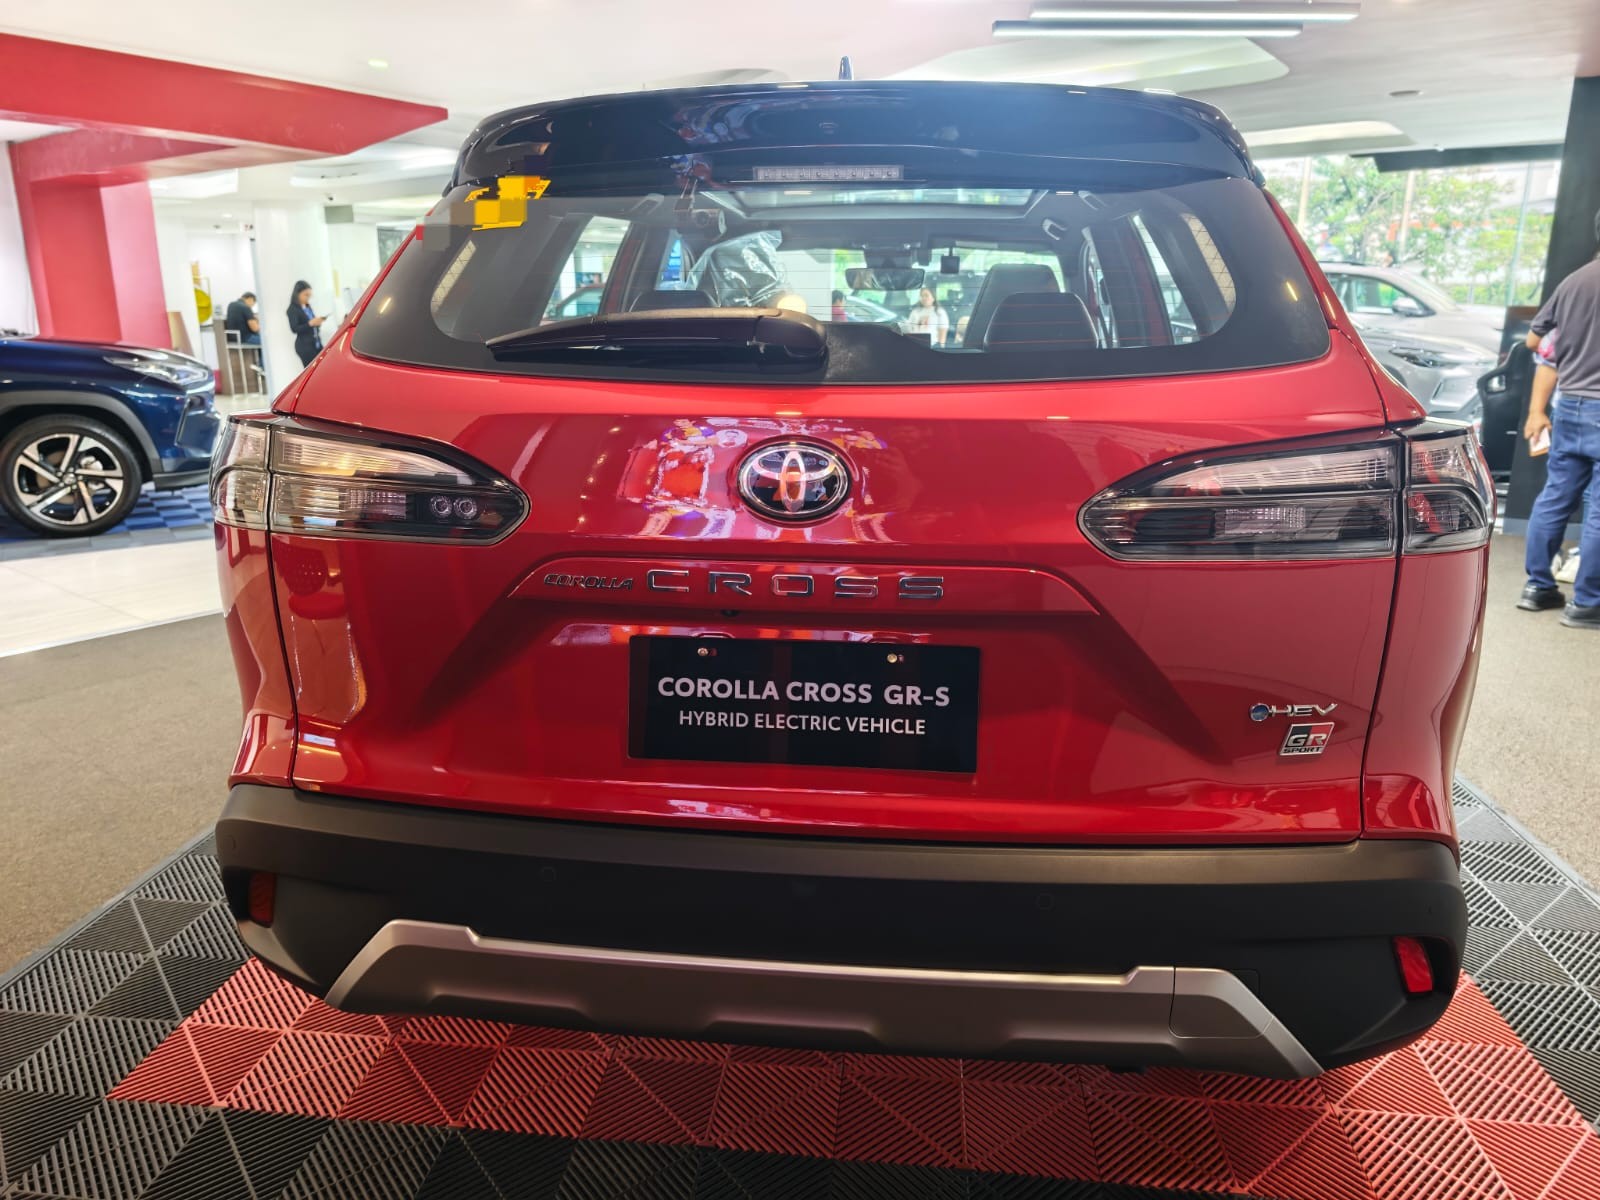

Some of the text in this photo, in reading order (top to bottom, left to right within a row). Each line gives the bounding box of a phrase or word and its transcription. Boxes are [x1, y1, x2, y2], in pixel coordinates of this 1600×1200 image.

[543, 569, 945, 598] COROLLA CROSS
[658, 677, 950, 707] COROLLA CROSS GR-S
[1270, 703, 1338, 717] HEV
[679, 710, 926, 735] HYBRID ELECTRIC VEHICLE
[1287, 733, 1327, 747] GR
[1283, 746, 1323, 754] SPORT
